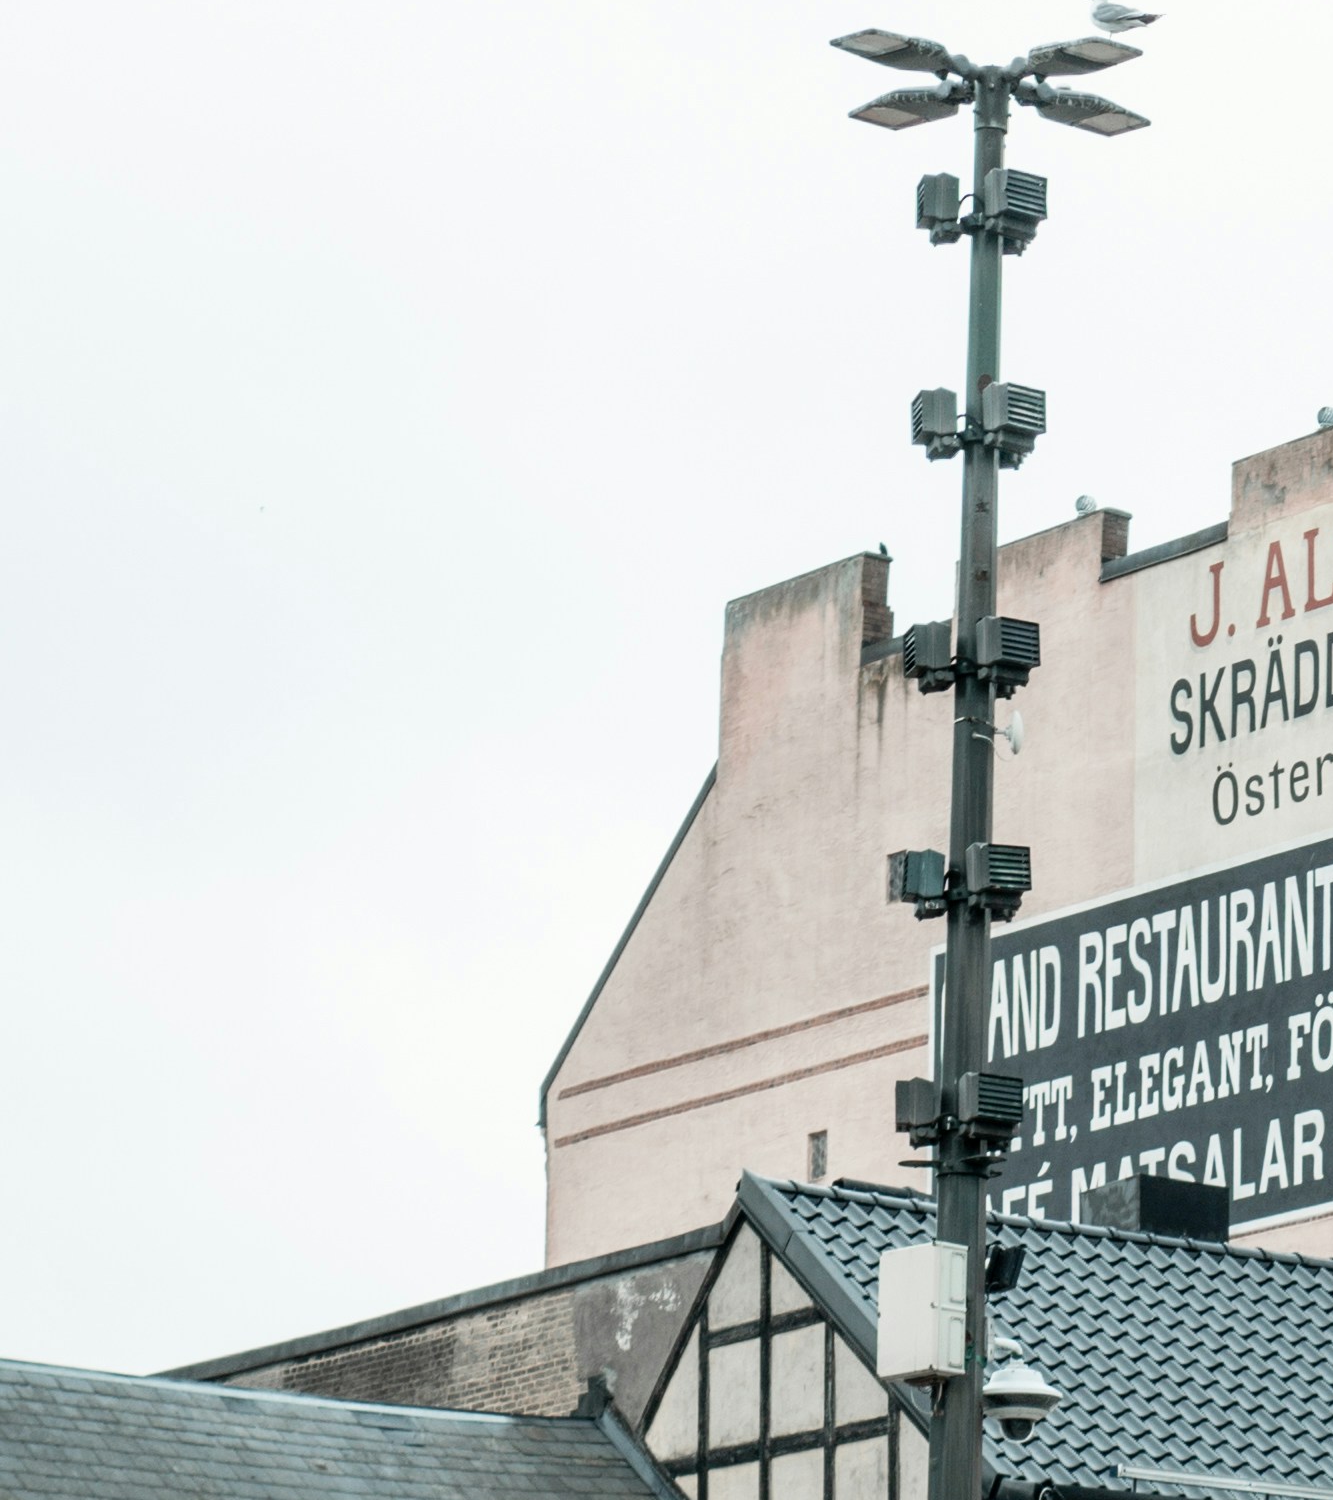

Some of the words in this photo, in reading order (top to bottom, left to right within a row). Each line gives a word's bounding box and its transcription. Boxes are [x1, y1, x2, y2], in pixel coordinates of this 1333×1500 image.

[1190, 561, 1236, 649] J.
[941, 946, 1062, 1063] AND
[1090, 1023, 1275, 1132] ELEGANT,
